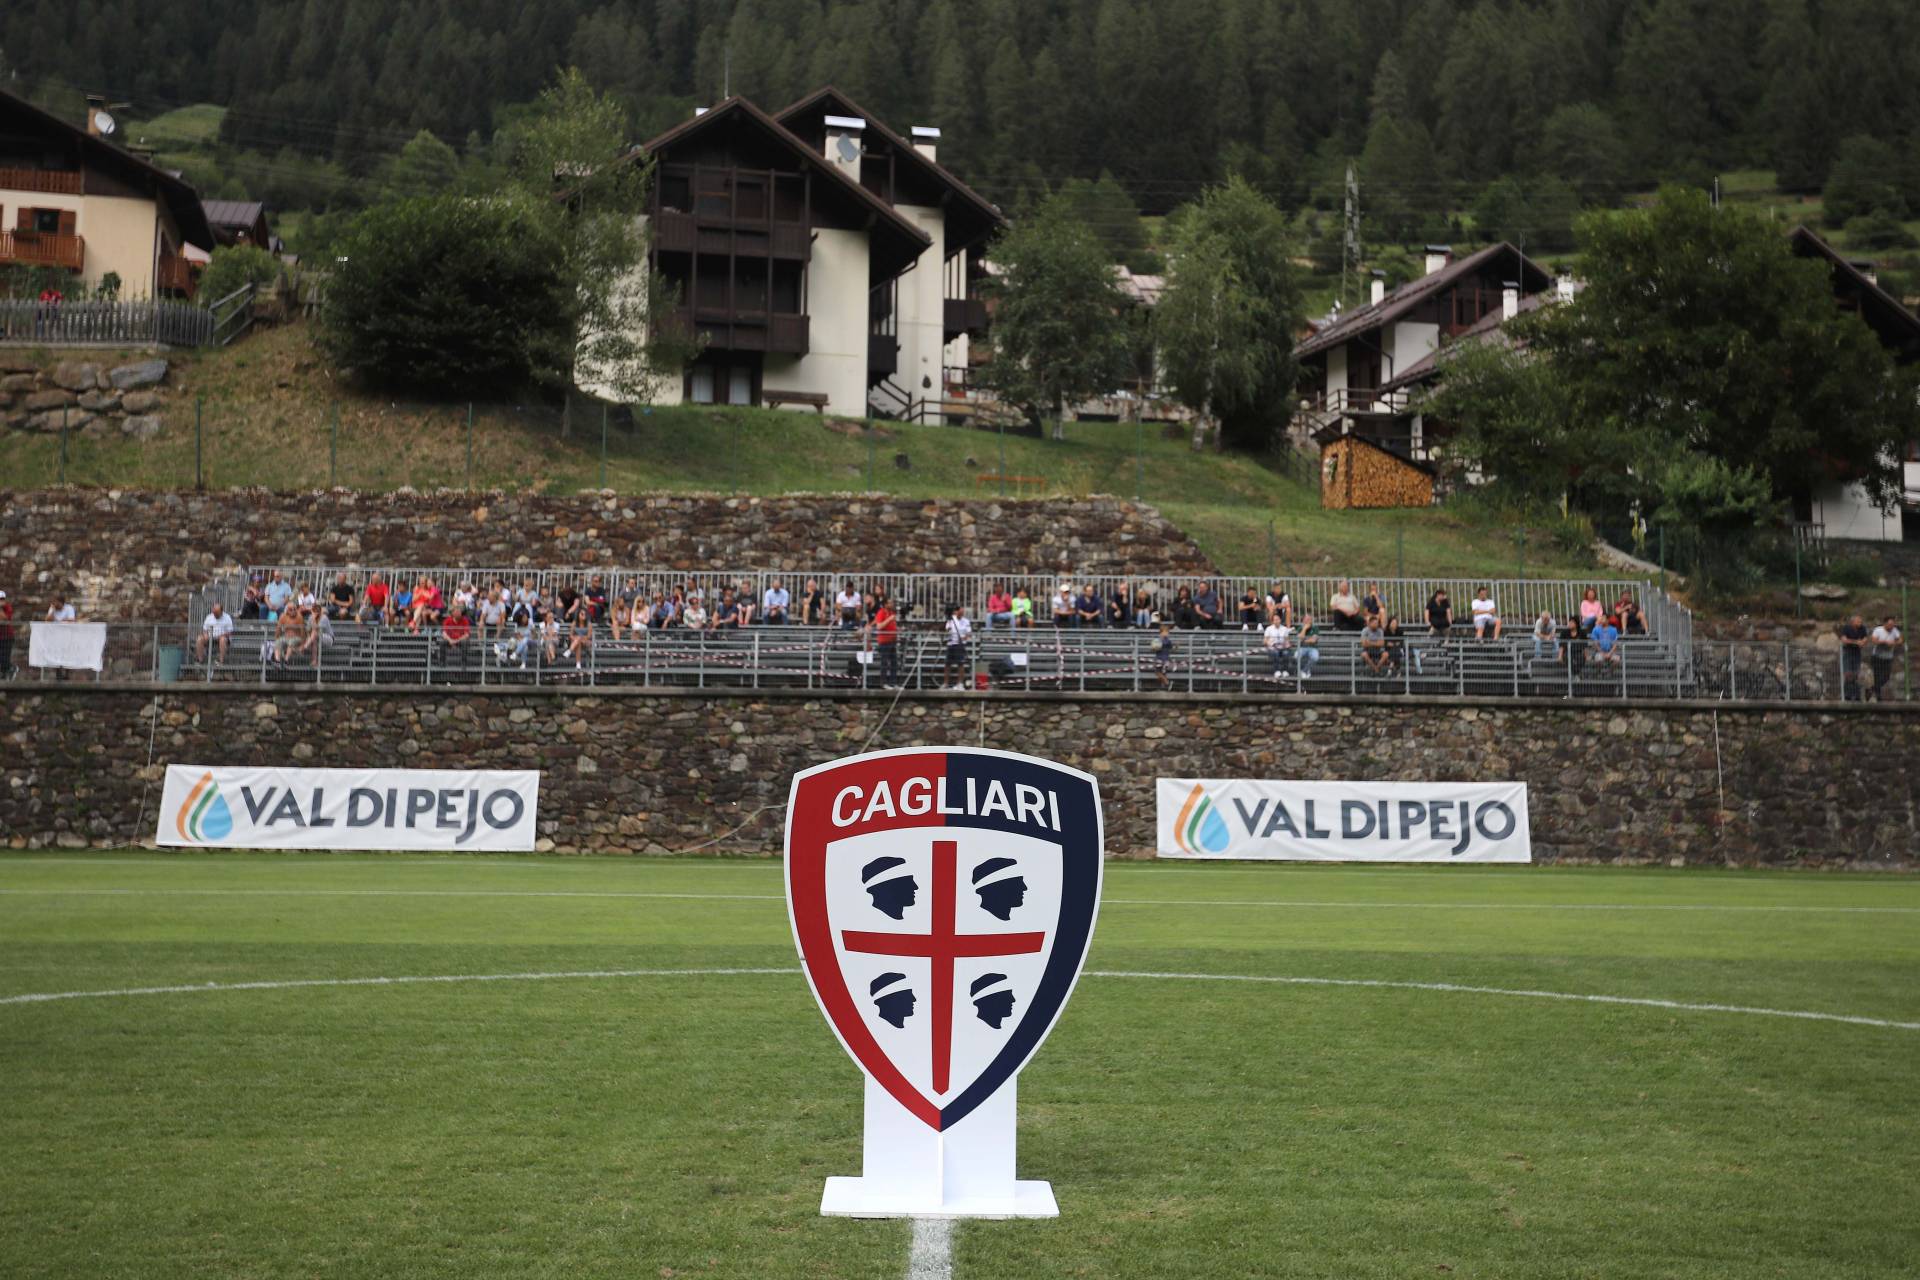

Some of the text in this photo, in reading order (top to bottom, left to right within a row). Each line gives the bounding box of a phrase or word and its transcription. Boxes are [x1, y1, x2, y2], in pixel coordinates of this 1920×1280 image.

[240, 786, 335, 827] VAL
[405, 788, 524, 844] PEJO
[831, 776, 1062, 832] CAGLIARI
[1232, 797, 1331, 839] VAL
[1398, 799, 1516, 856] PEJO
